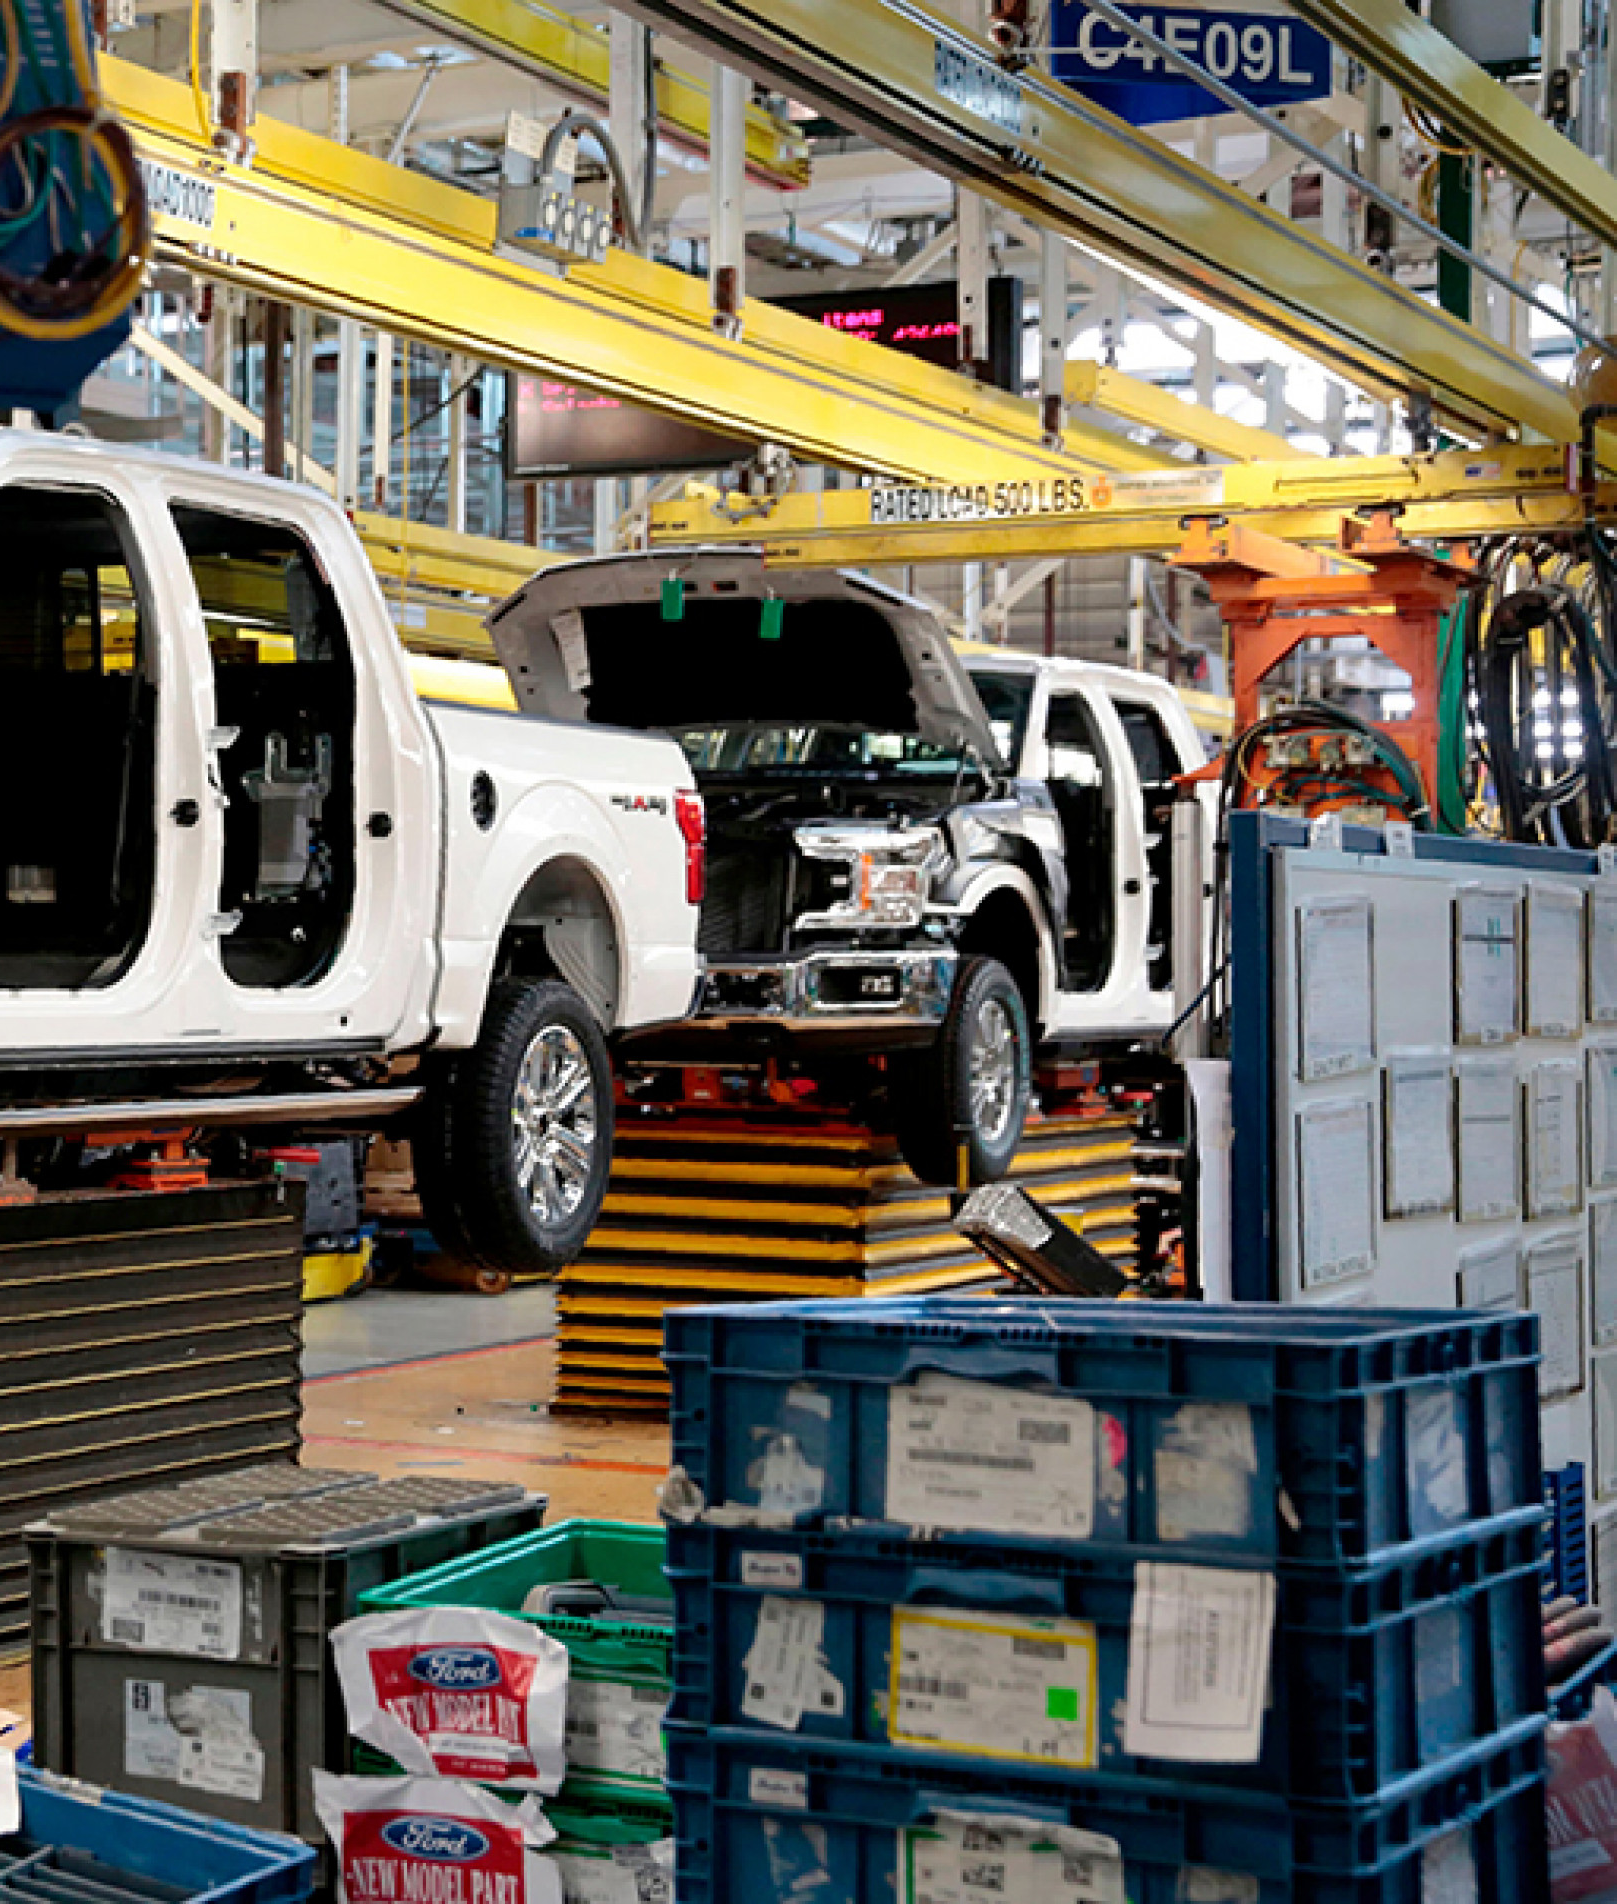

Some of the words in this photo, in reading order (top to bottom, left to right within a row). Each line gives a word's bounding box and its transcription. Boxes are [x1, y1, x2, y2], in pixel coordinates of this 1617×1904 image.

[1079, 11, 1314, 84] C4E09L
[871, 488, 932, 521] RATED
[938, 485, 988, 519] LOAD
[994, 482, 1035, 515] 500
[1038, 479, 1089, 512] LBS.
[427, 1655, 490, 1682] Ford
[402, 1822, 467, 1854] Ford
[352, 1858, 398, 1898] NEW
[401, 1860, 465, 1904] MODEL
[470, 1869, 519, 1904] PART
